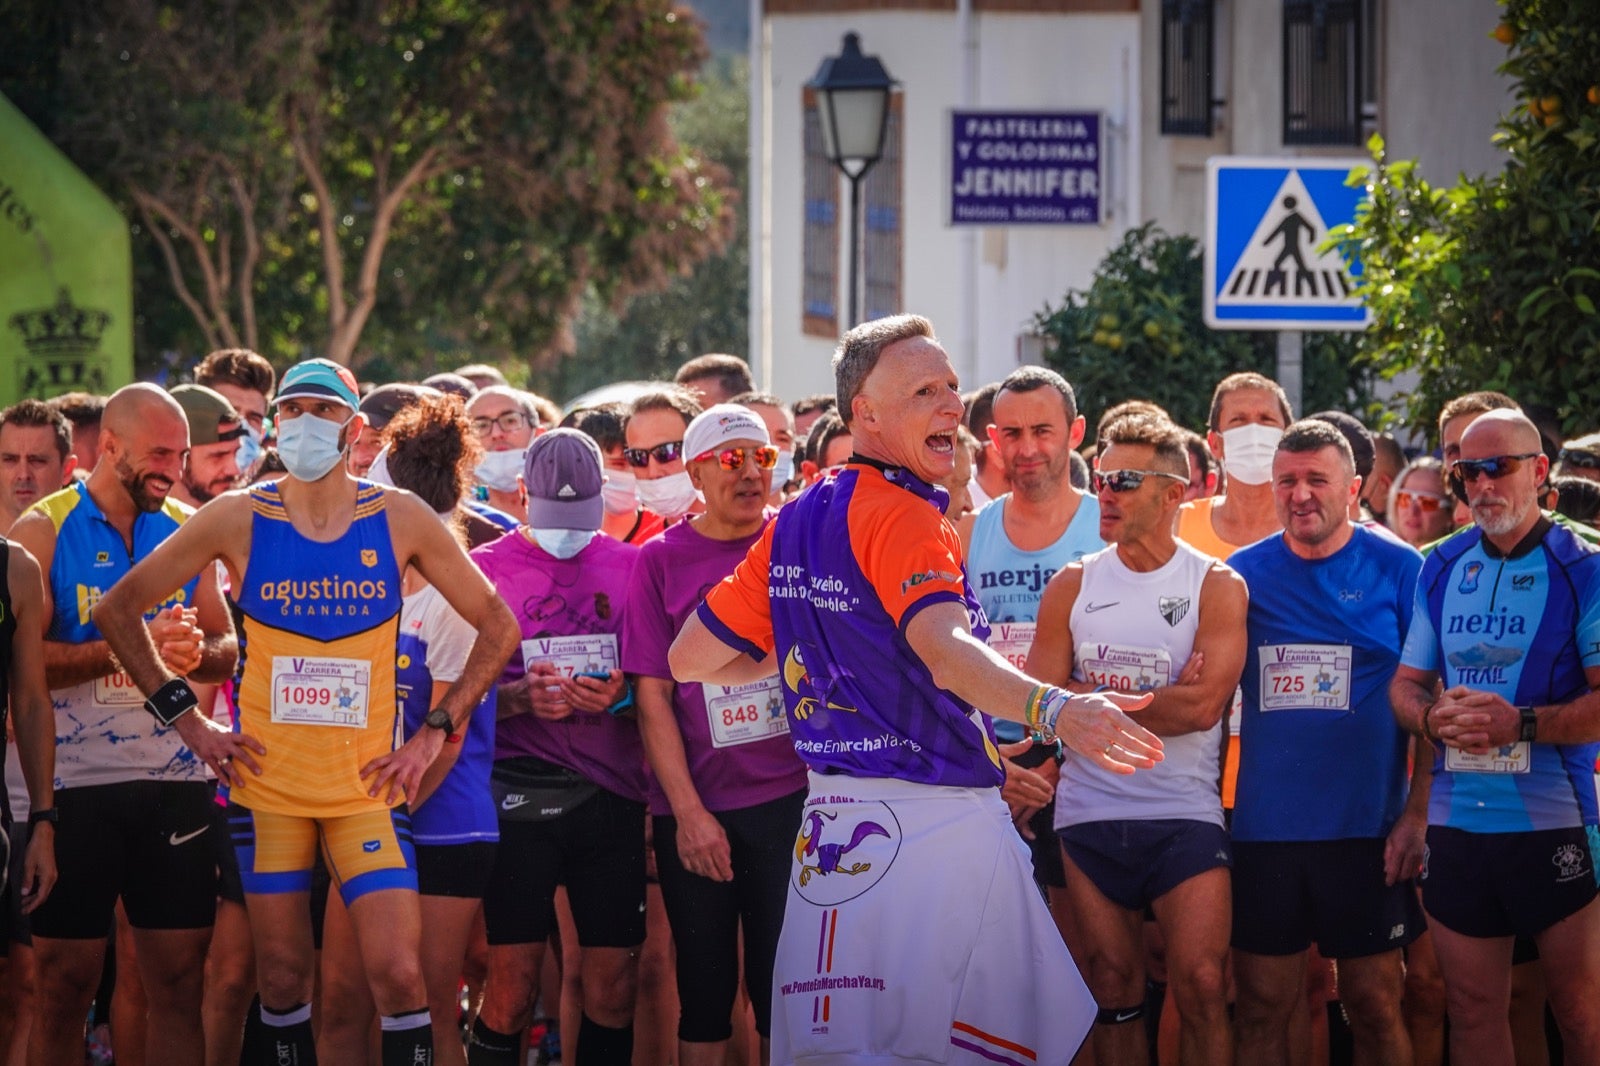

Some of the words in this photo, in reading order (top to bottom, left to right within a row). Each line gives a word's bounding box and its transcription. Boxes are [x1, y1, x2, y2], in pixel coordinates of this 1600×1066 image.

[965, 118, 1089, 139] PASTELERIA
[956, 141, 973, 160] Y
[954, 166, 1098, 199] JENNIFER
[261, 575, 387, 606] agustinos
[281, 605, 370, 616] GRANADA
[1447, 606, 1527, 641] nerja
[539, 640, 551, 654] V
[552, 645, 588, 654] CARRERA
[1097, 644, 1109, 660] V
[1107, 654, 1142, 664] CARRERA
[1276, 647, 1286, 662] V
[292, 658, 305, 673] V
[304, 667, 342, 675] CARRERA
[1456, 666, 1508, 685] TRAIL
[733, 681, 769, 693] CARRERA
[1089, 671, 1131, 690] 1160
[1272, 676, 1305, 694] 725
[281, 686, 331, 706] 1099
[722, 704, 759, 727] 848
[506, 794, 525, 803] NIKE
[541, 807, 562, 815] SPORT
